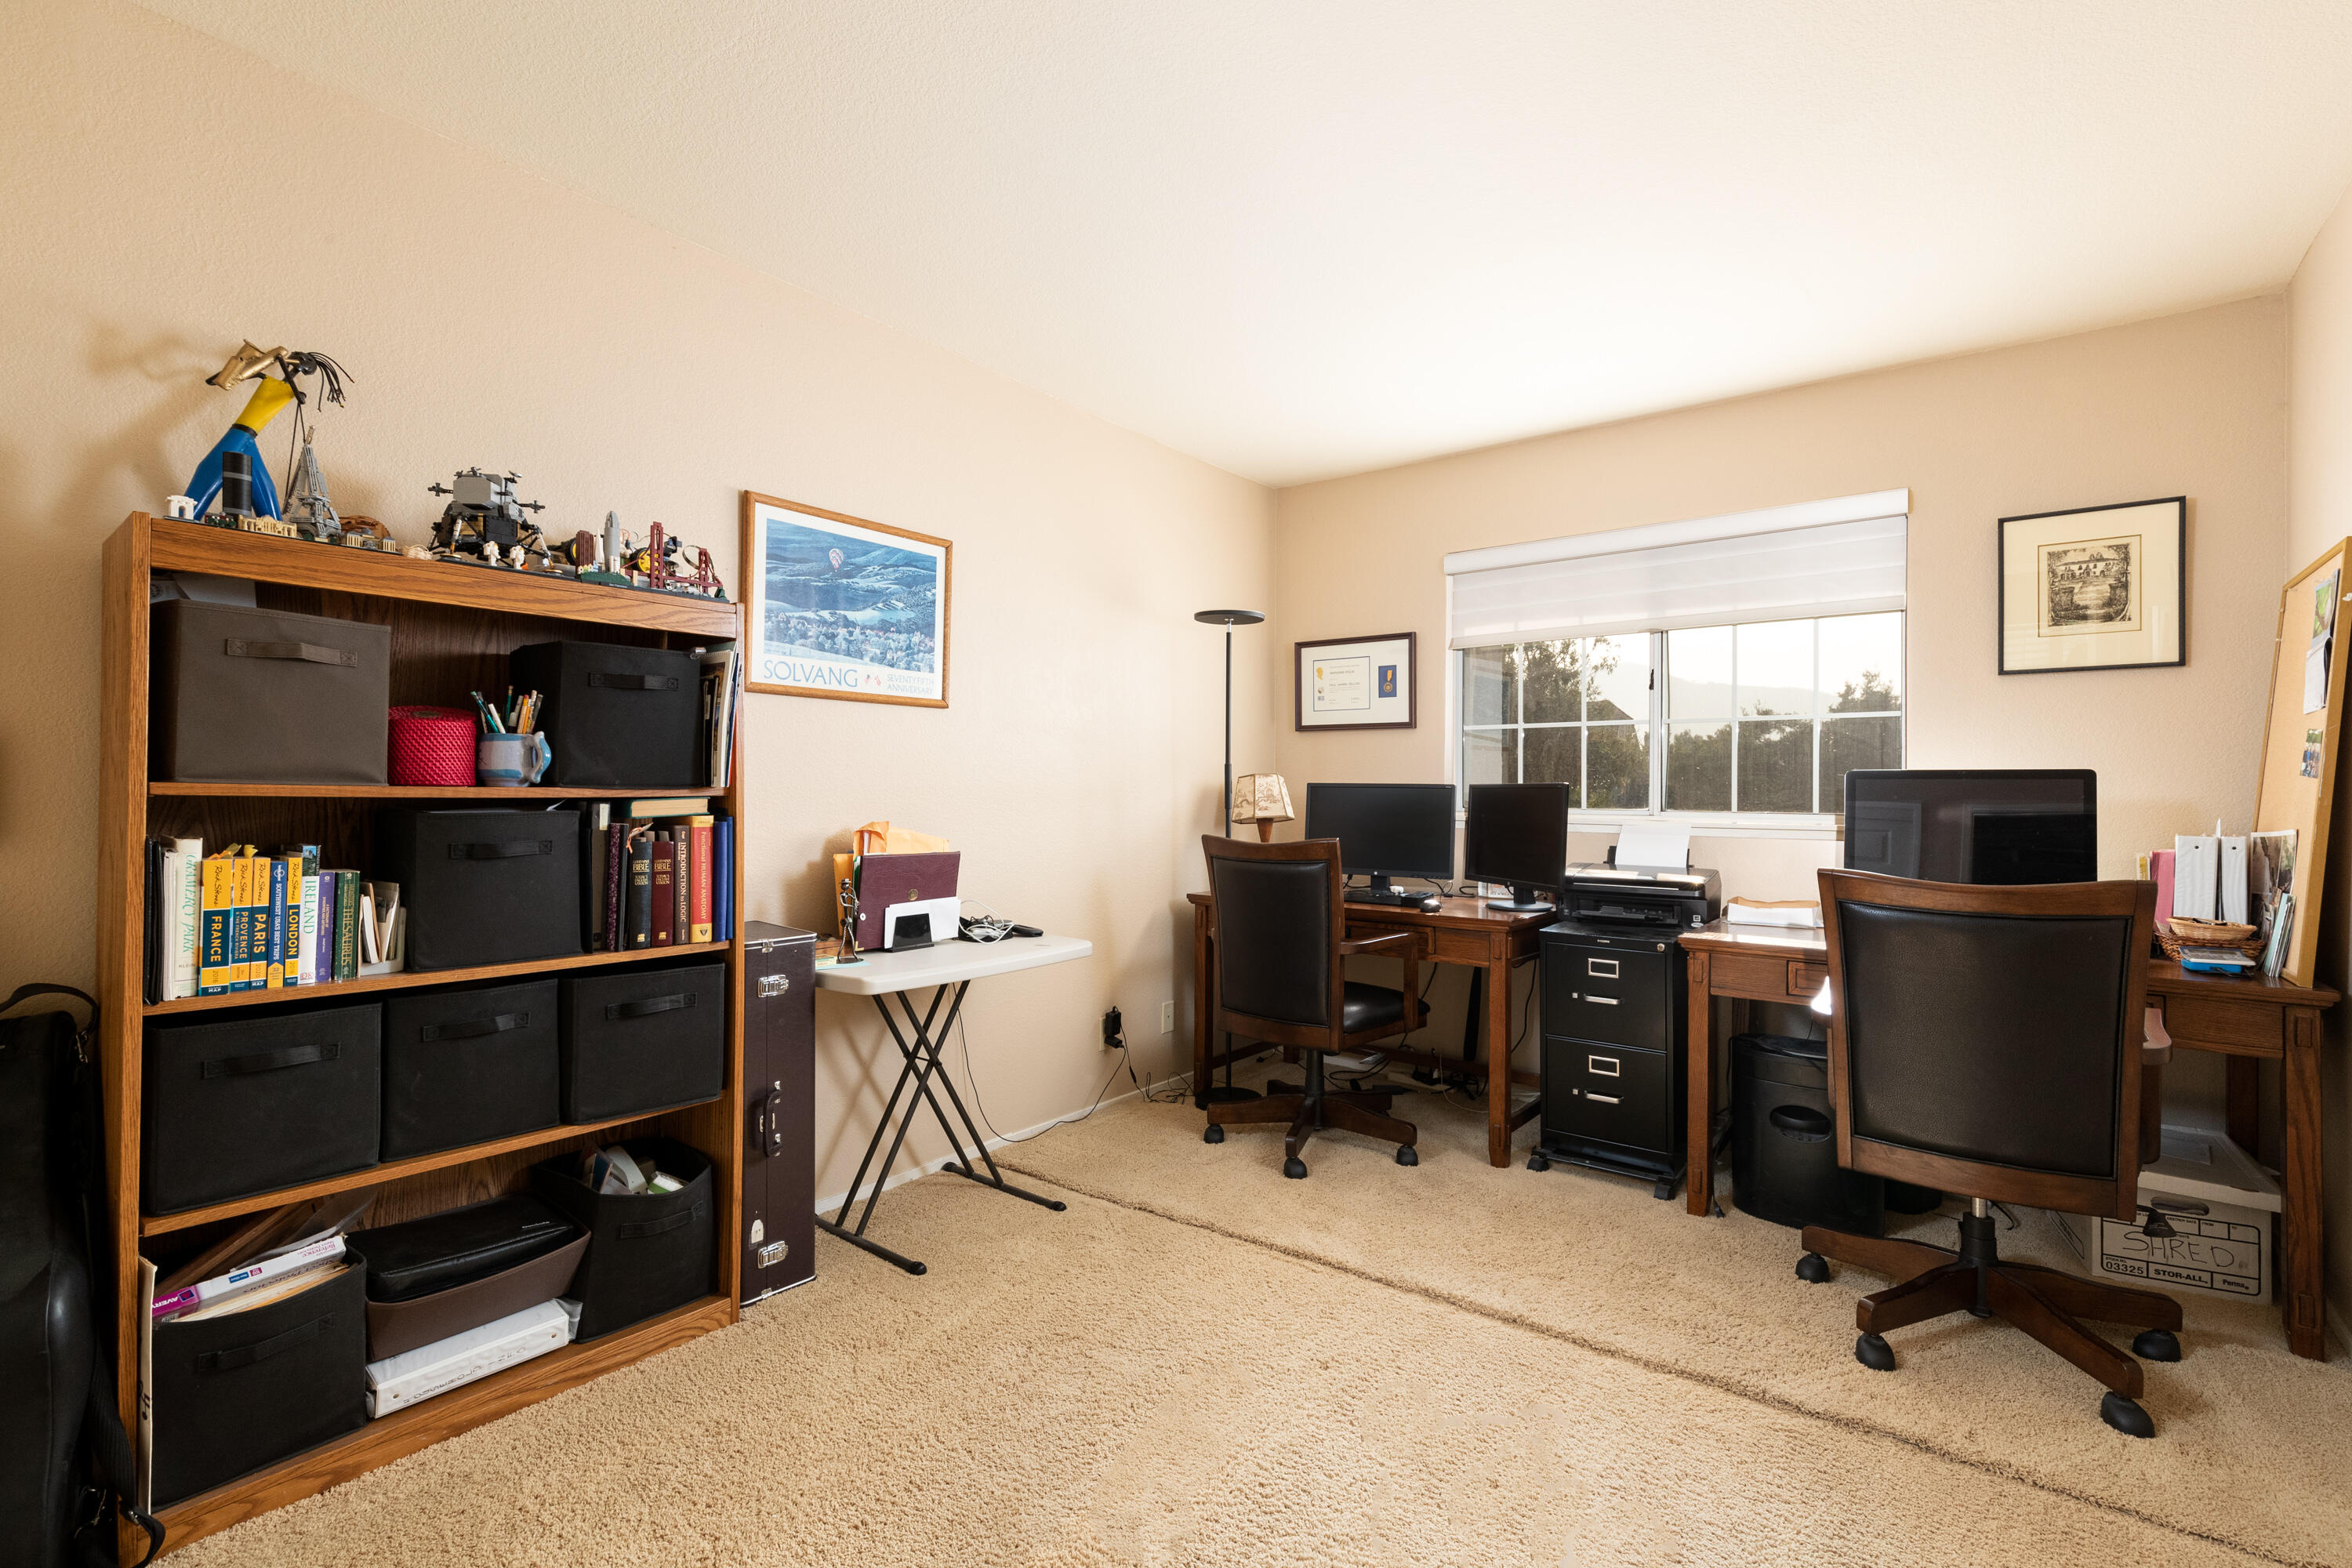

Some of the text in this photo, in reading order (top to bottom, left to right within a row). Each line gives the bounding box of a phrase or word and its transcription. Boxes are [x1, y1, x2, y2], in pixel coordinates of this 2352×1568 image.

[764, 659, 858, 688] SOLVANG
[887, 673, 935, 686] SEVENTY FIFTH
[887, 684, 934, 695] ANNIVERSARY
[213, 865, 223, 906] Rick Steves
[239, 863, 248, 904] Rick Steves
[257, 878, 266, 903] Steves
[181, 855, 197, 955] GRAMERCY PARK
[303, 880, 317, 934] IRELAND
[210, 916, 223, 963] FRANCE
[239, 911, 249, 959] PROVENCE
[253, 913, 267, 953] PARIS
[288, 909, 299, 956] LONDON
[342, 907, 354, 965] THESAURUS
[303, 1243, 336, 1258] Reference
[2106, 1261, 2144, 1275] 03325
[2123, 1232, 2235, 1268] SHRED
[2154, 1269, 2207, 1284] STOR-ALL
[151, 1296, 179, 1308] AVERY
